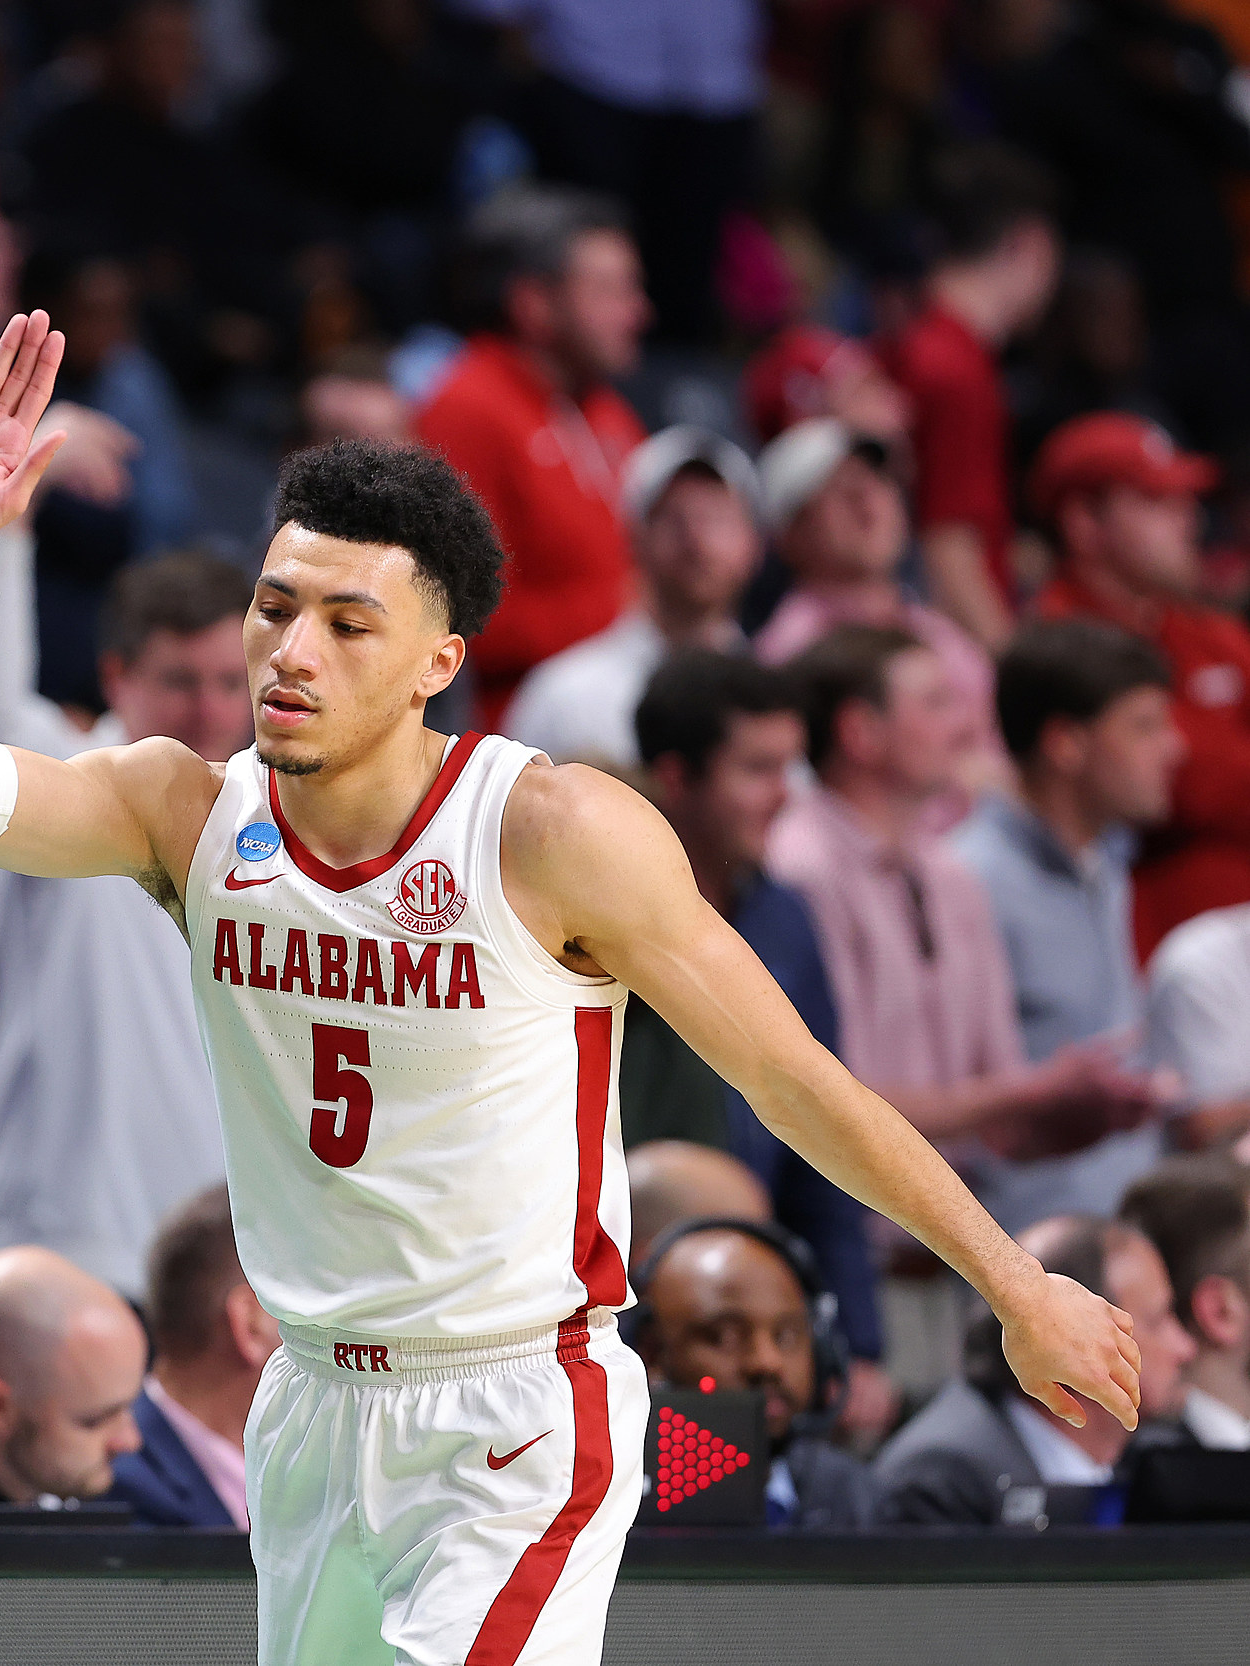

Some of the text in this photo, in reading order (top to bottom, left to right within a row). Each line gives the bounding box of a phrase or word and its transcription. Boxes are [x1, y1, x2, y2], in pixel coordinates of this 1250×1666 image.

[240, 837, 276, 852] NCAA
[404, 862, 453, 914] SEC
[397, 908, 459, 932] GRADUATE
[213, 919, 486, 1009] ALABAMA
[309, 1023, 374, 1169] 5
[334, 1342, 393, 1373] RTR
